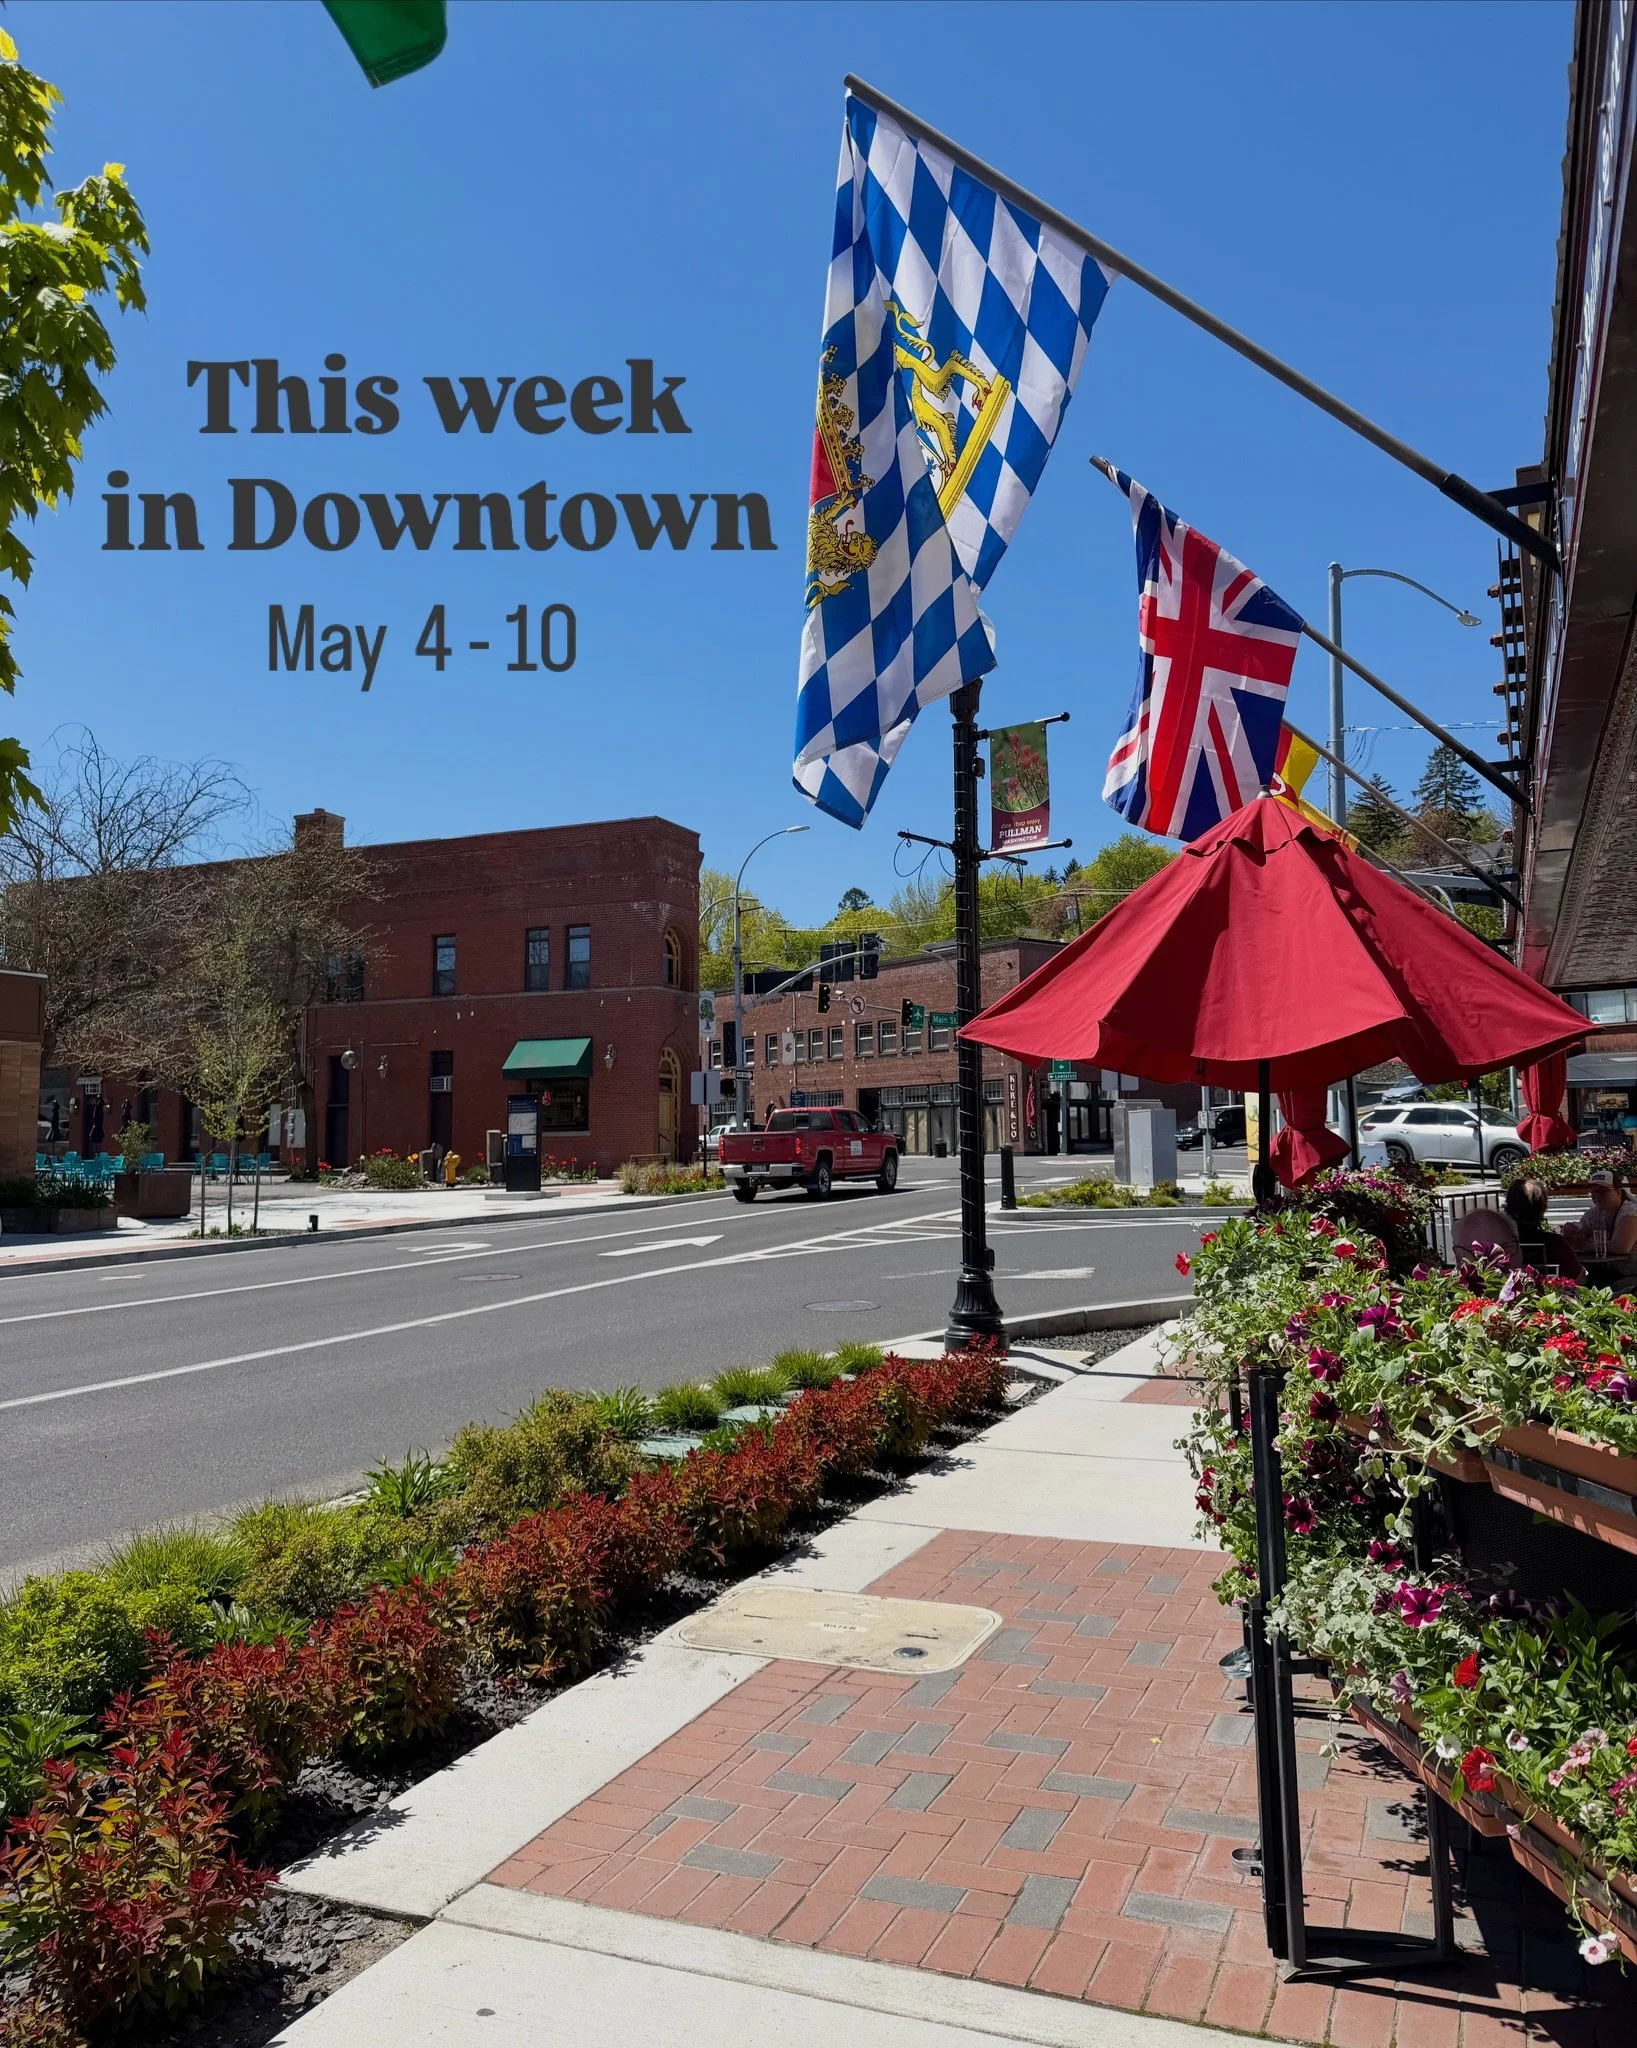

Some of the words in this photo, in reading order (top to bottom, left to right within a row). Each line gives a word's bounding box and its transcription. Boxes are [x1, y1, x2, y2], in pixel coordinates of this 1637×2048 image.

[999, 825, 1042, 839] PULLMAN
[933, 1015, 948, 1024] Main
[1010, 1122, 1017, 1138] CO
